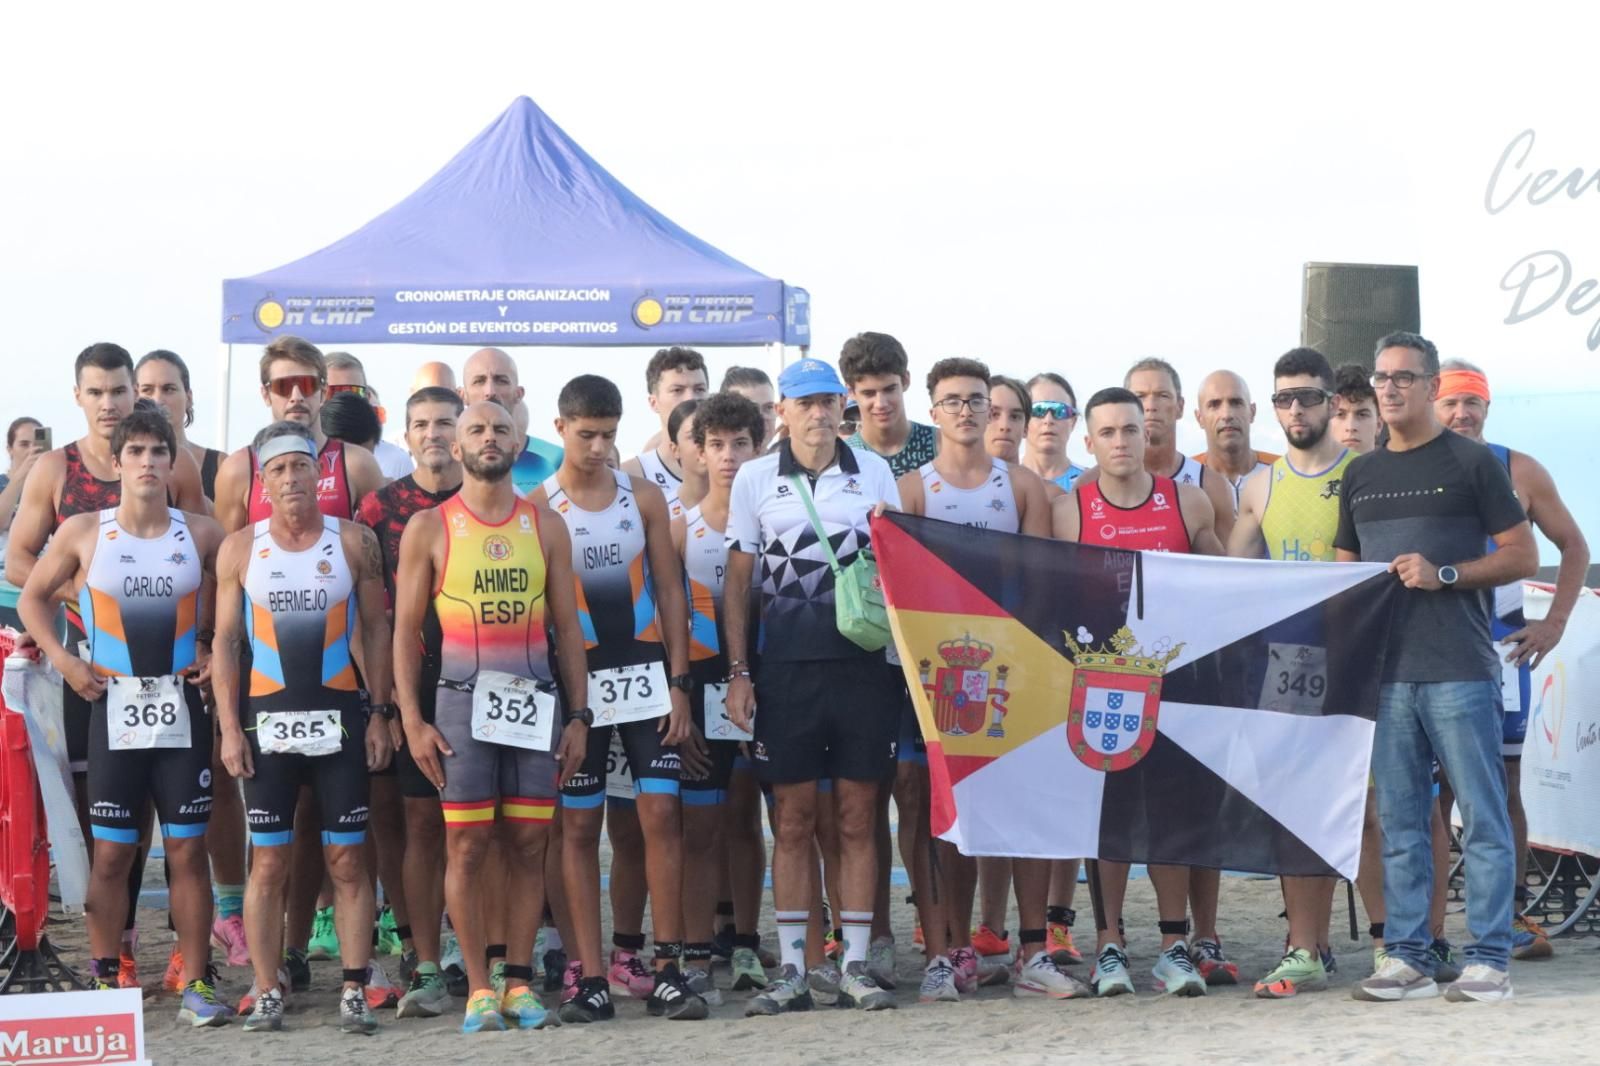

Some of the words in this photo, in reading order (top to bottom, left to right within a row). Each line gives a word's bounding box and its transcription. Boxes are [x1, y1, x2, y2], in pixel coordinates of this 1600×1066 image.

[395, 290, 504, 302] CRONOMETRAJE
[506, 289, 610, 302] ORGANIZACIÓN
[309, 307, 375, 326] CHIP
[498, 305, 508, 317] Y
[688, 306, 755, 324] CHIP
[388, 321, 447, 335] GESTIÓN
[449, 322, 468, 334] DE
[469, 322, 531, 334] EVENTOS
[532, 321, 618, 333] DEPORTIVOS
[583, 543, 623, 569] ISMAEL
[123, 575, 173, 597] CARLOS
[473, 567, 529, 595] AHMED
[268, 588, 328, 612] BERMEJO
[480, 600, 526, 625] ESP
[600, 675, 653, 704] 373
[1277, 671, 1326, 698] 349
[123, 702, 177, 728] 368
[486, 695, 538, 727] 352
[273, 720, 326, 740] 365
[0, 1025, 127, 1061] Maruja
